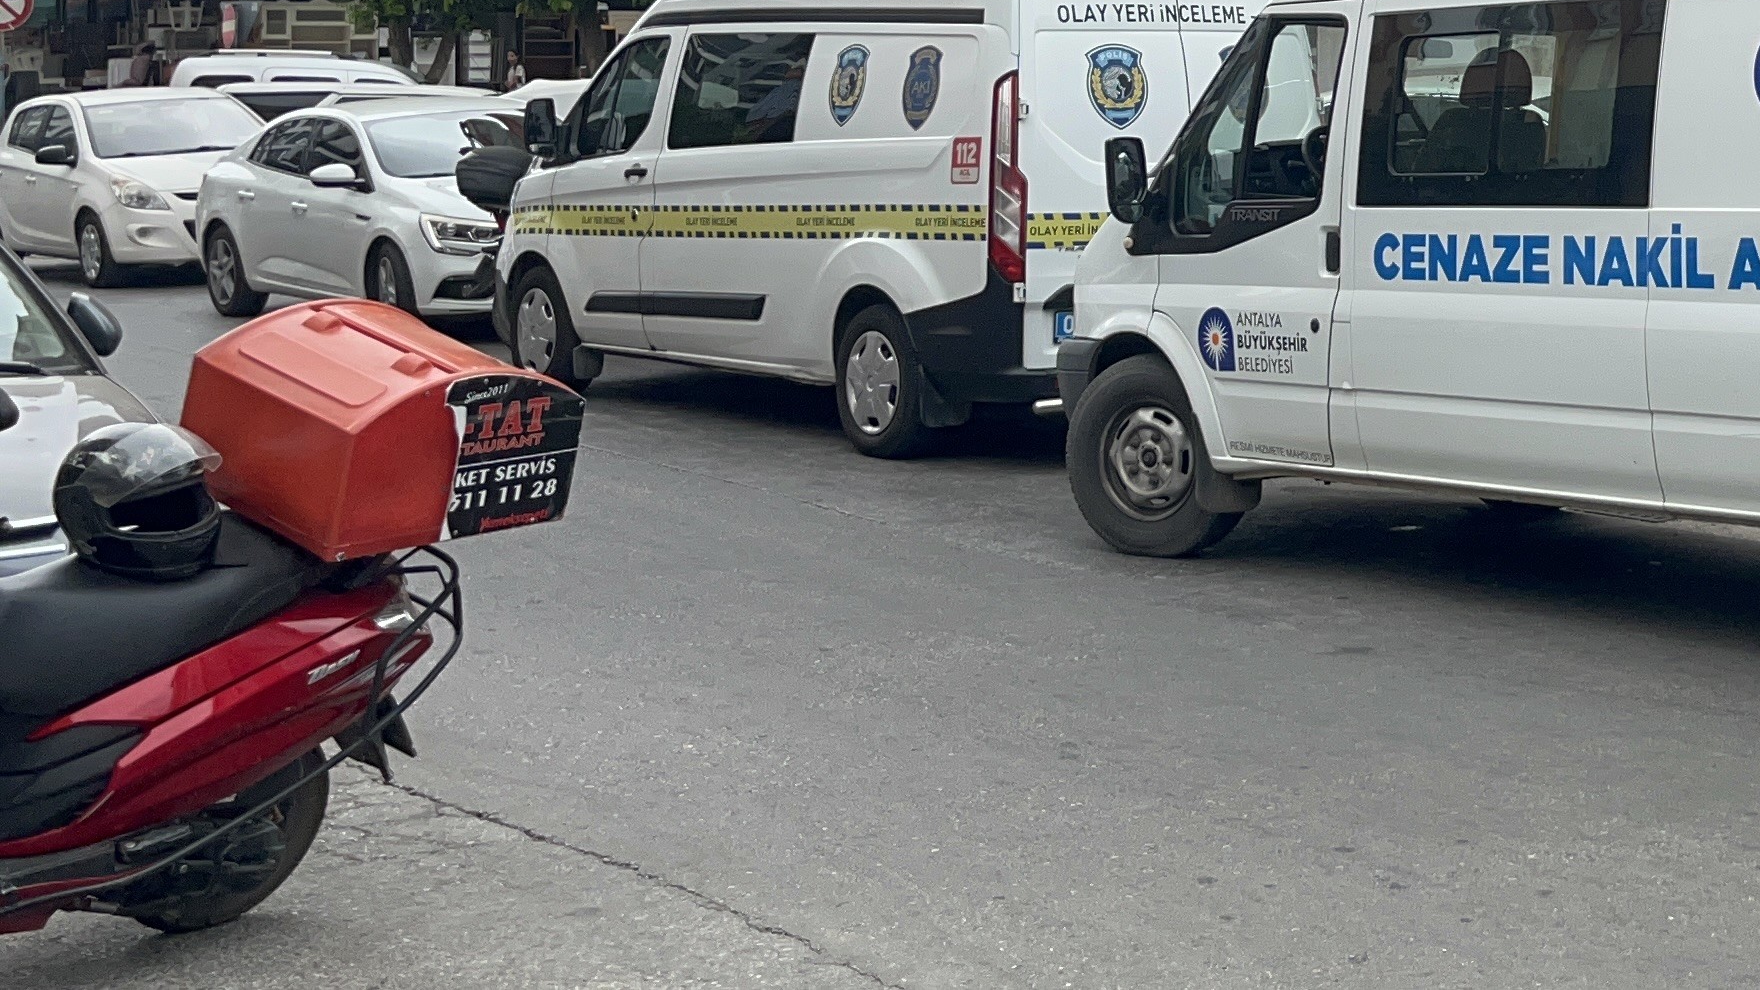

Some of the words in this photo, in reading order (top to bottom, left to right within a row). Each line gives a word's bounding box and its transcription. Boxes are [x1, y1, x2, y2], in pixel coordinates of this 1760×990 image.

[1057, 3, 1107, 23] OLAY
[956, 142, 977, 165] 112
[915, 217, 932, 227] OLAY
[1230, 208, 1282, 223] TRANSIT
[1029, 226, 1058, 236] OLAY
[1373, 232, 1550, 284] CENAZE
[1563, 223, 1714, 291] NAKİL
[1236, 311, 1282, 328] ANTALYA
[1237, 329, 1308, 354] BÜYÜKŞEHİR
[1238, 356, 1293, 374] BELEDİYESİ
[494, 457, 557, 482] SERVİS
[500, 483, 522, 504] 11
[531, 477, 558, 499] 28
